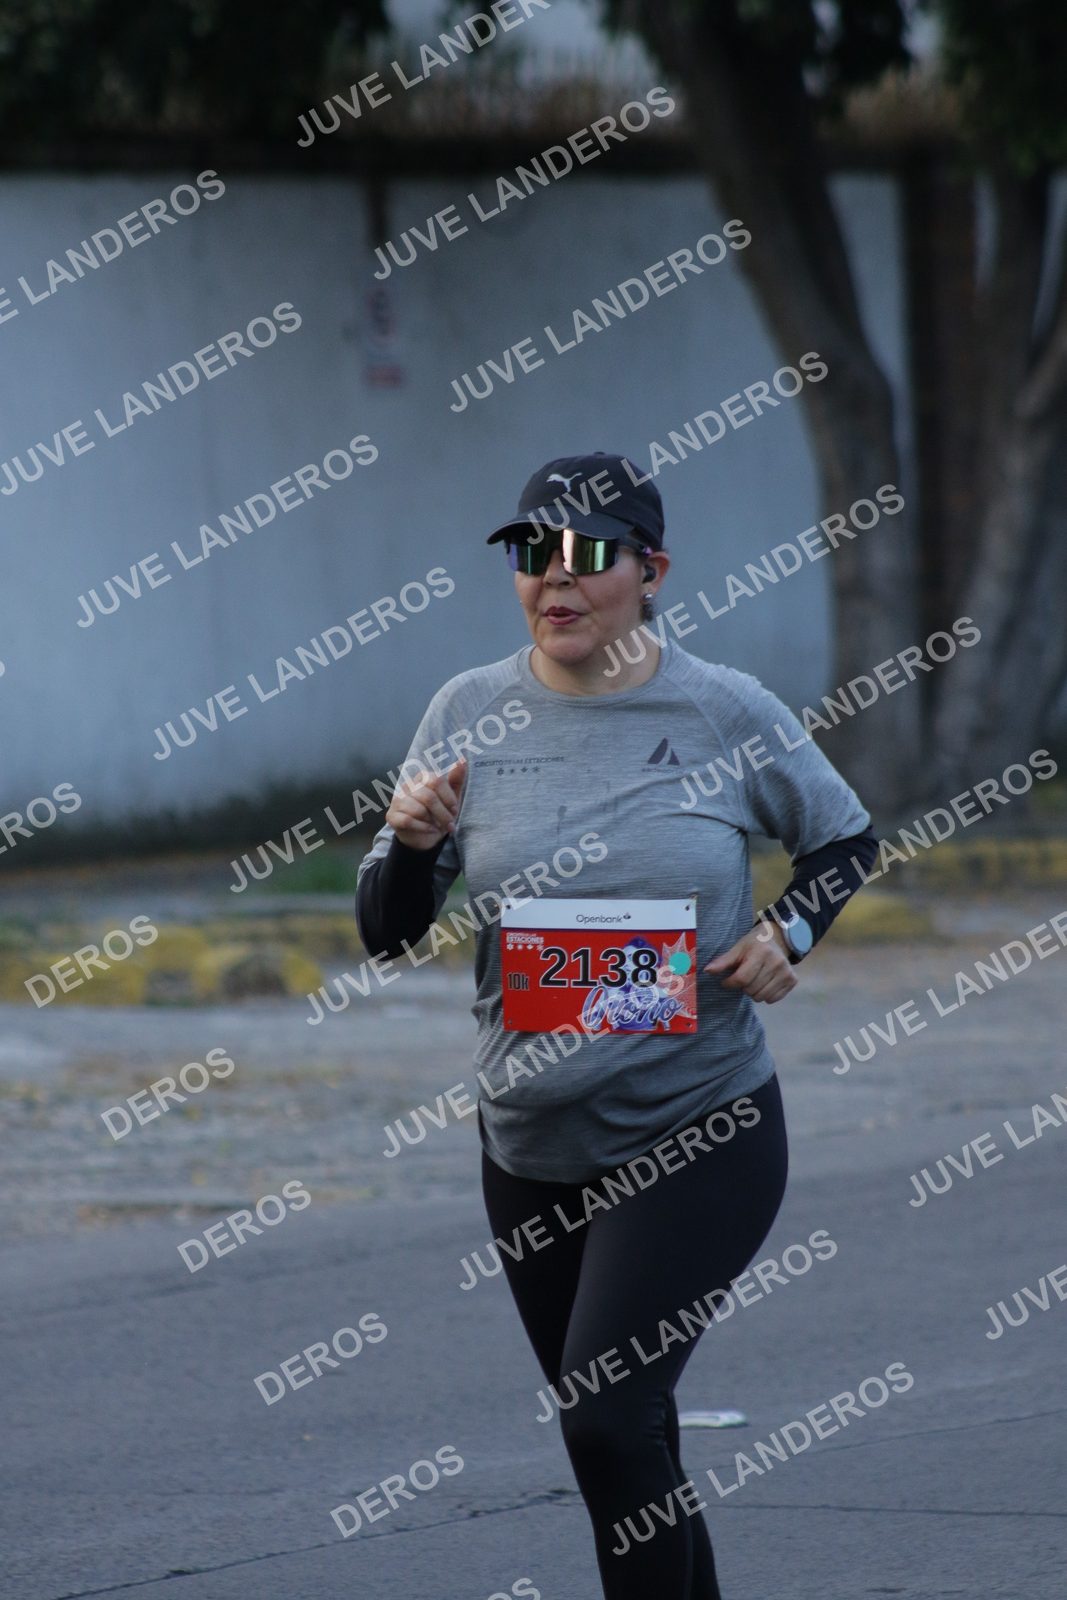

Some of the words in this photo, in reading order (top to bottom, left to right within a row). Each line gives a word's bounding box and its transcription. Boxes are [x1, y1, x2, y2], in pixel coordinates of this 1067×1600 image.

[576, 914, 622, 924] Openbank
[540, 947, 658, 987] 2138
[507, 972, 529, 991] 10k
